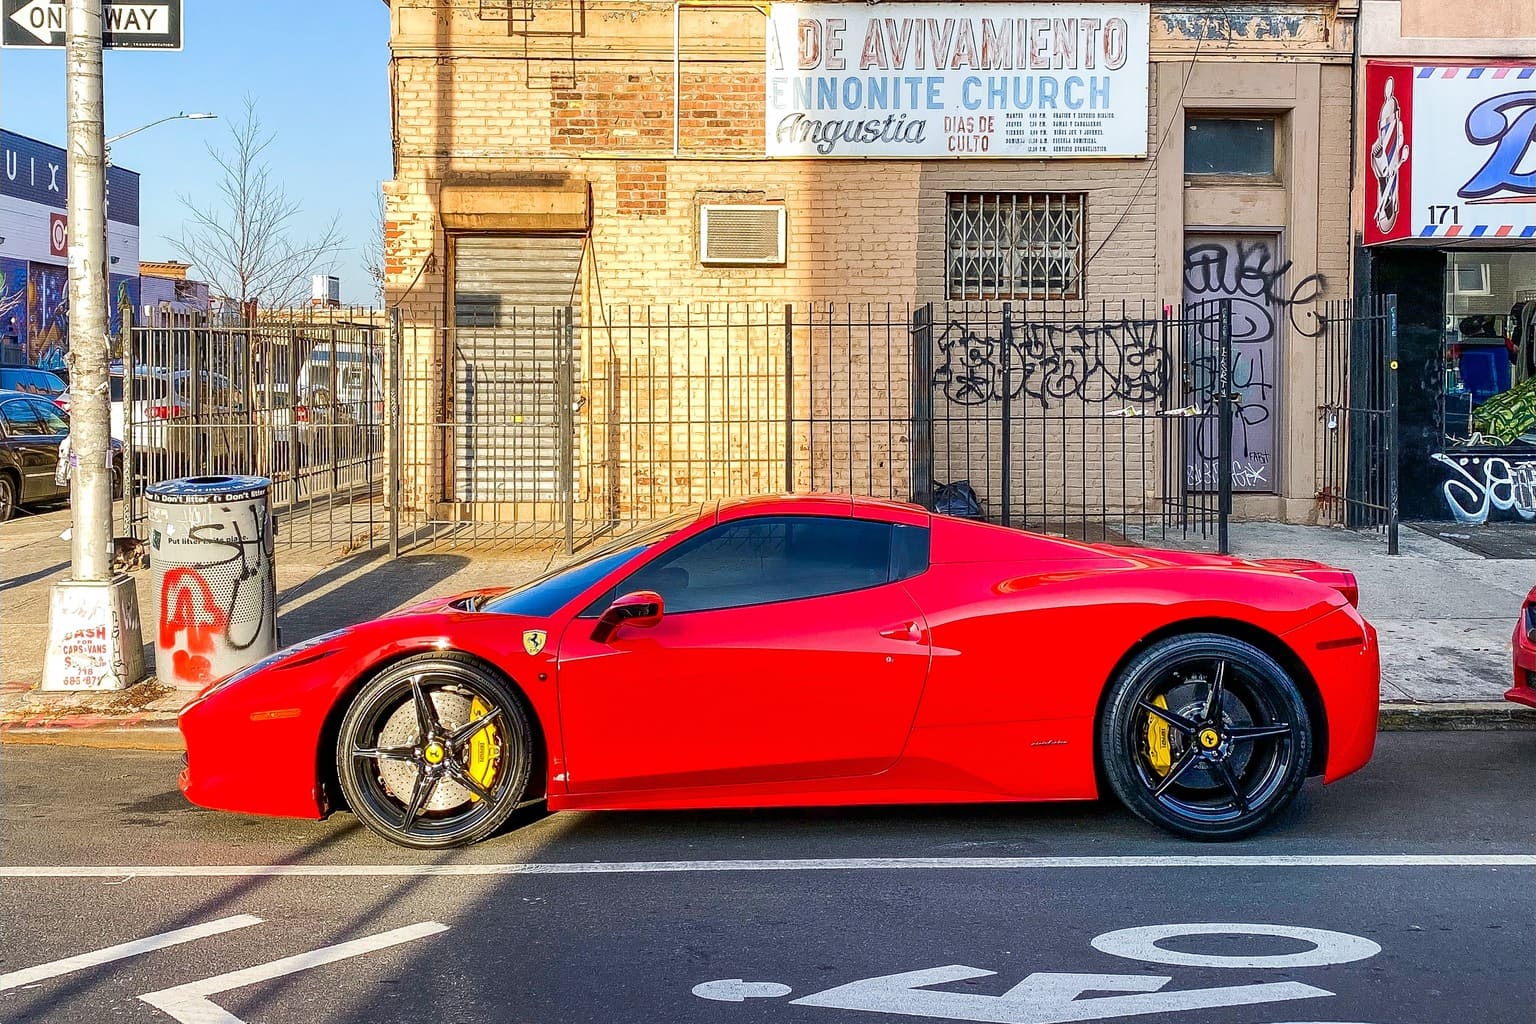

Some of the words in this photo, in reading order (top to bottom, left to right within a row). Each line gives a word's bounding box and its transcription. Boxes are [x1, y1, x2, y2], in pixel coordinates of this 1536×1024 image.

[105, 8, 157, 31] WAY
[798, 18, 846, 70] DE
[859, 17, 1128, 71] AVIVAMIENTO
[962, 75, 1110, 110] CHURCH
[775, 112, 927, 155] Angustia
[944, 116, 974, 134] DIAS
[979, 115, 995, 133] DE
[948, 135, 989, 153] CULTO
[1427, 205, 1459, 225] 171
[161, 494, 183, 503] Don't
[185, 495, 208, 503] litter
[225, 491, 249, 501] Don't
[167, 537, 180, 545] Put
